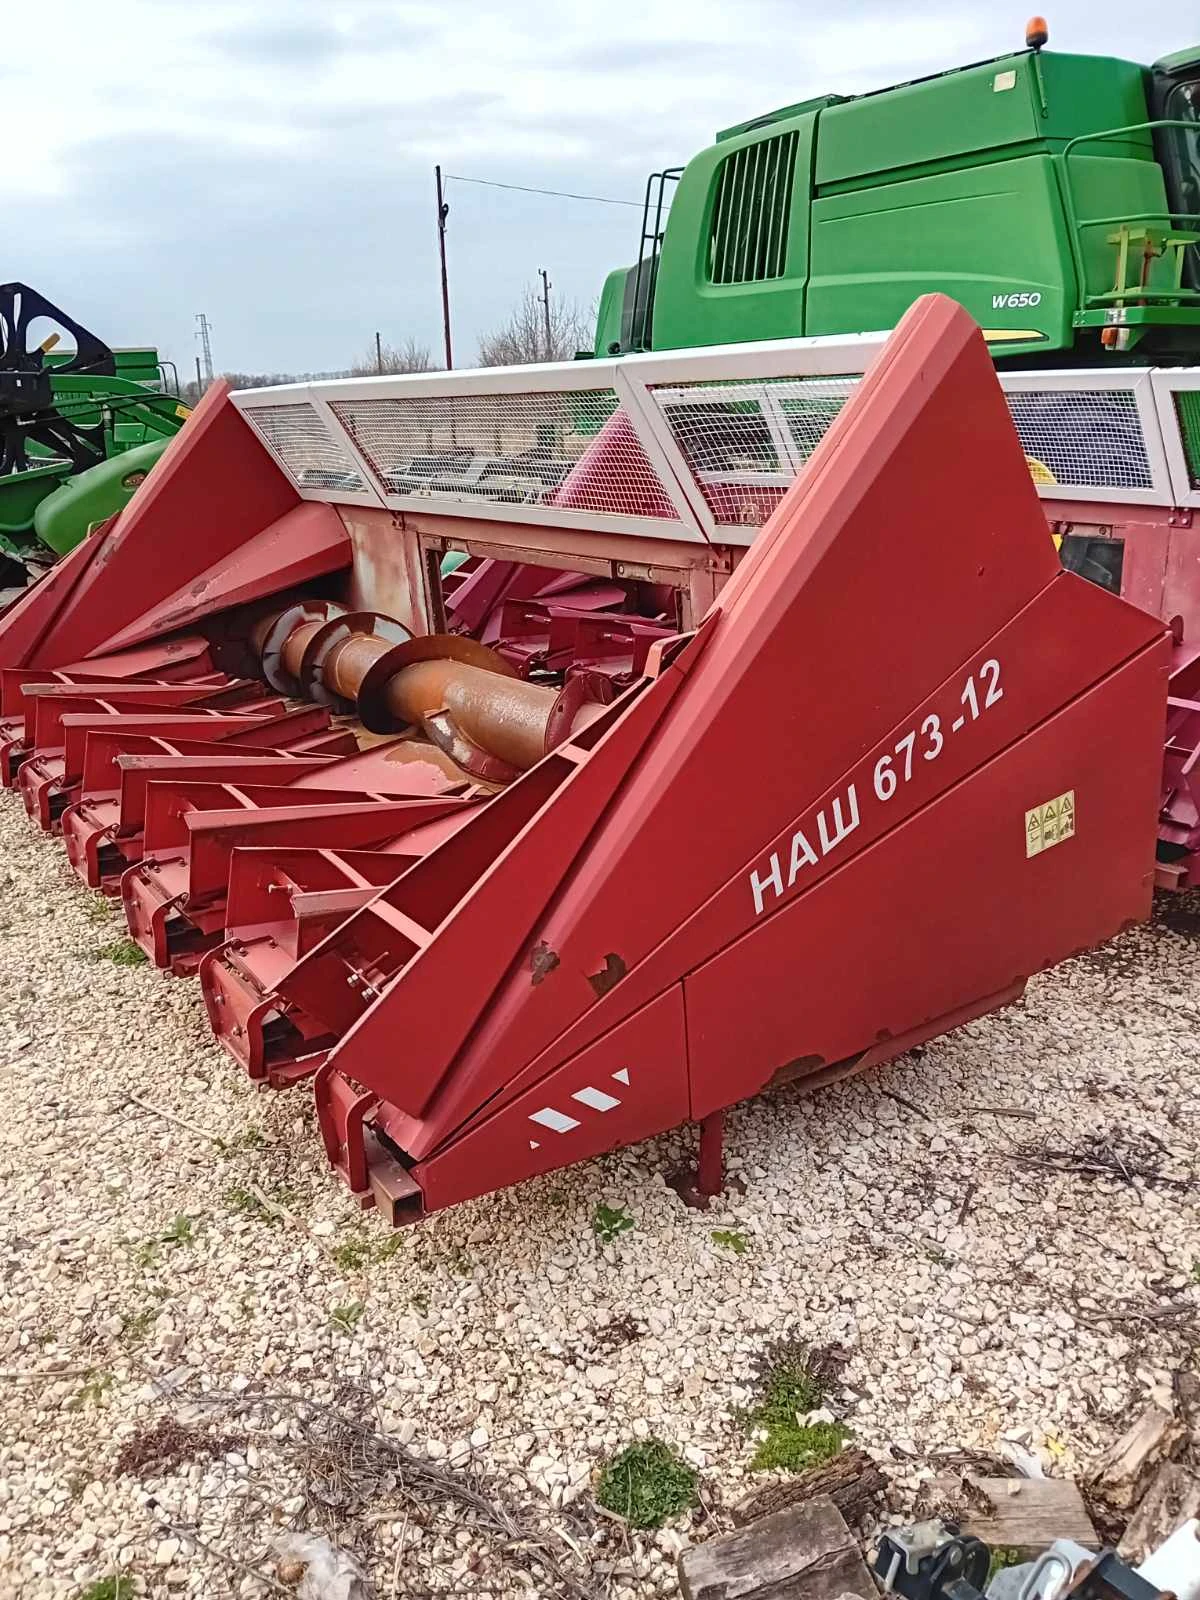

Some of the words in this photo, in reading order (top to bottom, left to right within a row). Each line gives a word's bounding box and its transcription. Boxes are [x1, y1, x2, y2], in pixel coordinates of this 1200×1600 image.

[992, 292, 1042, 309] W650
[749, 783, 860, 915] НАШ
[873, 658, 1004, 802] 673-12
